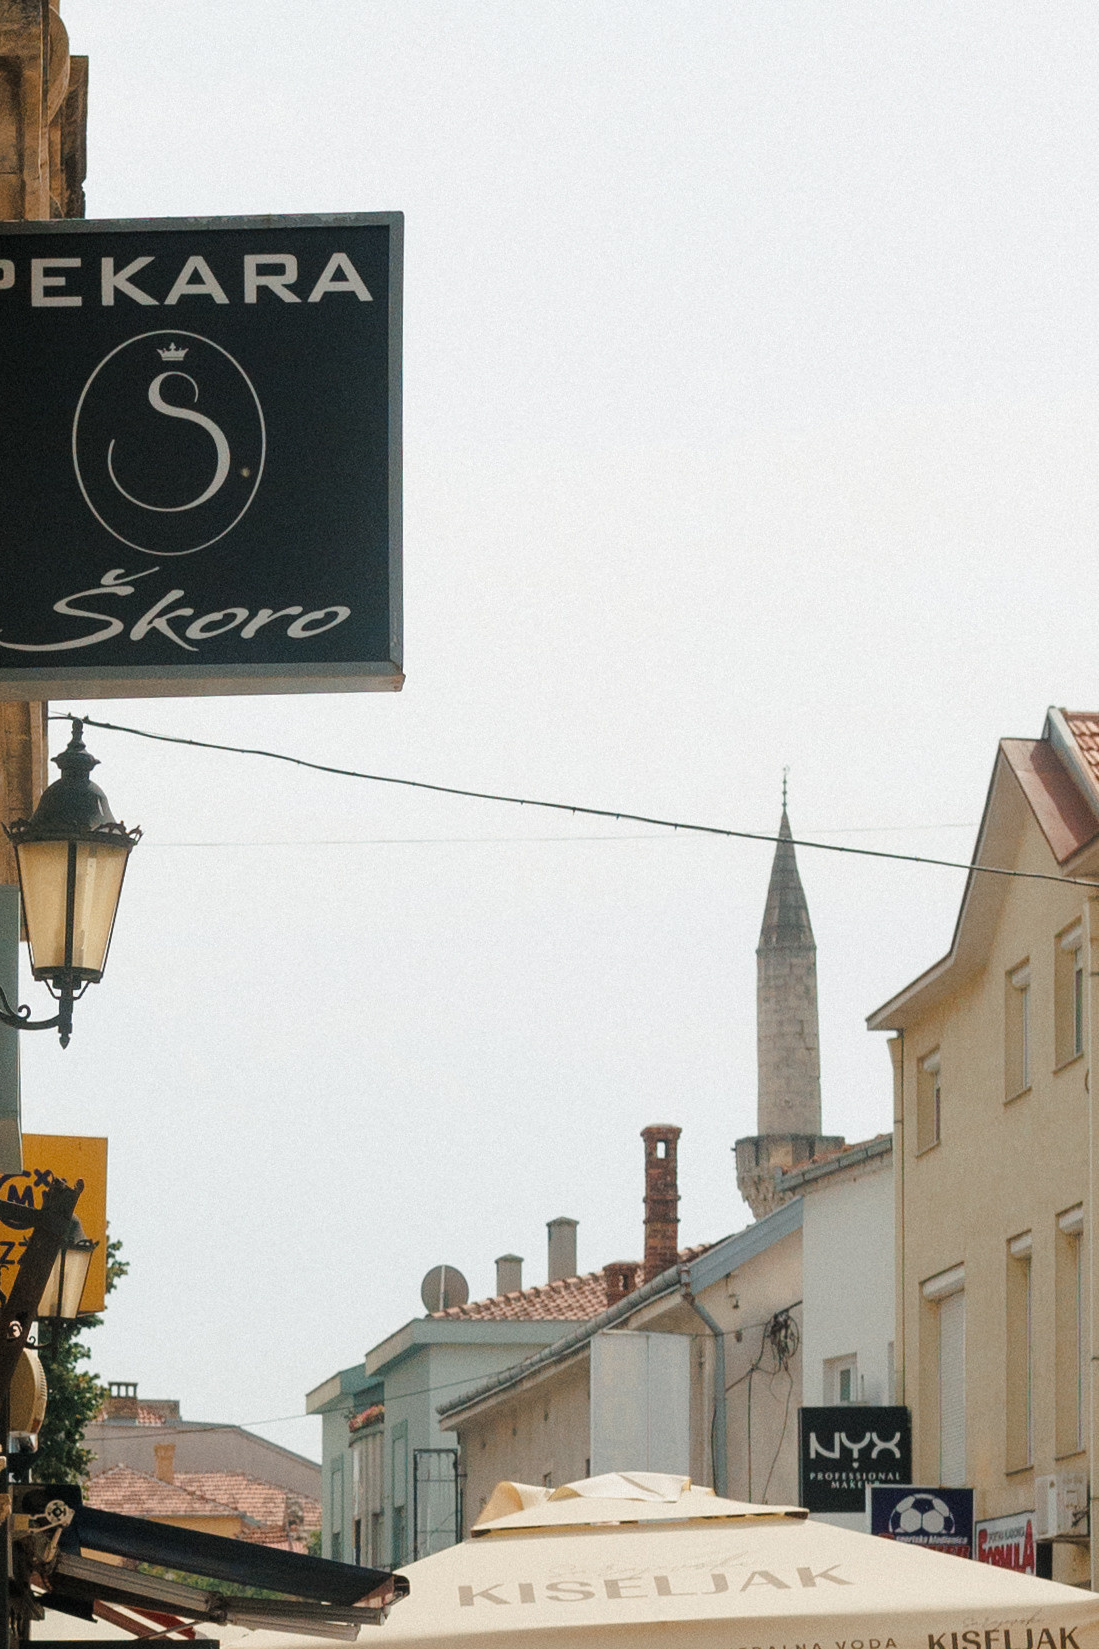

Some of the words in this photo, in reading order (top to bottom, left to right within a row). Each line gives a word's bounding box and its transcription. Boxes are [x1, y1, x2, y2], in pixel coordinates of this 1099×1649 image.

[809, 1432, 901, 1459] NYX
[809, 1472, 900, 1480] PROFESSIONAL
[457, 1564, 855, 1607] KISELJAK
